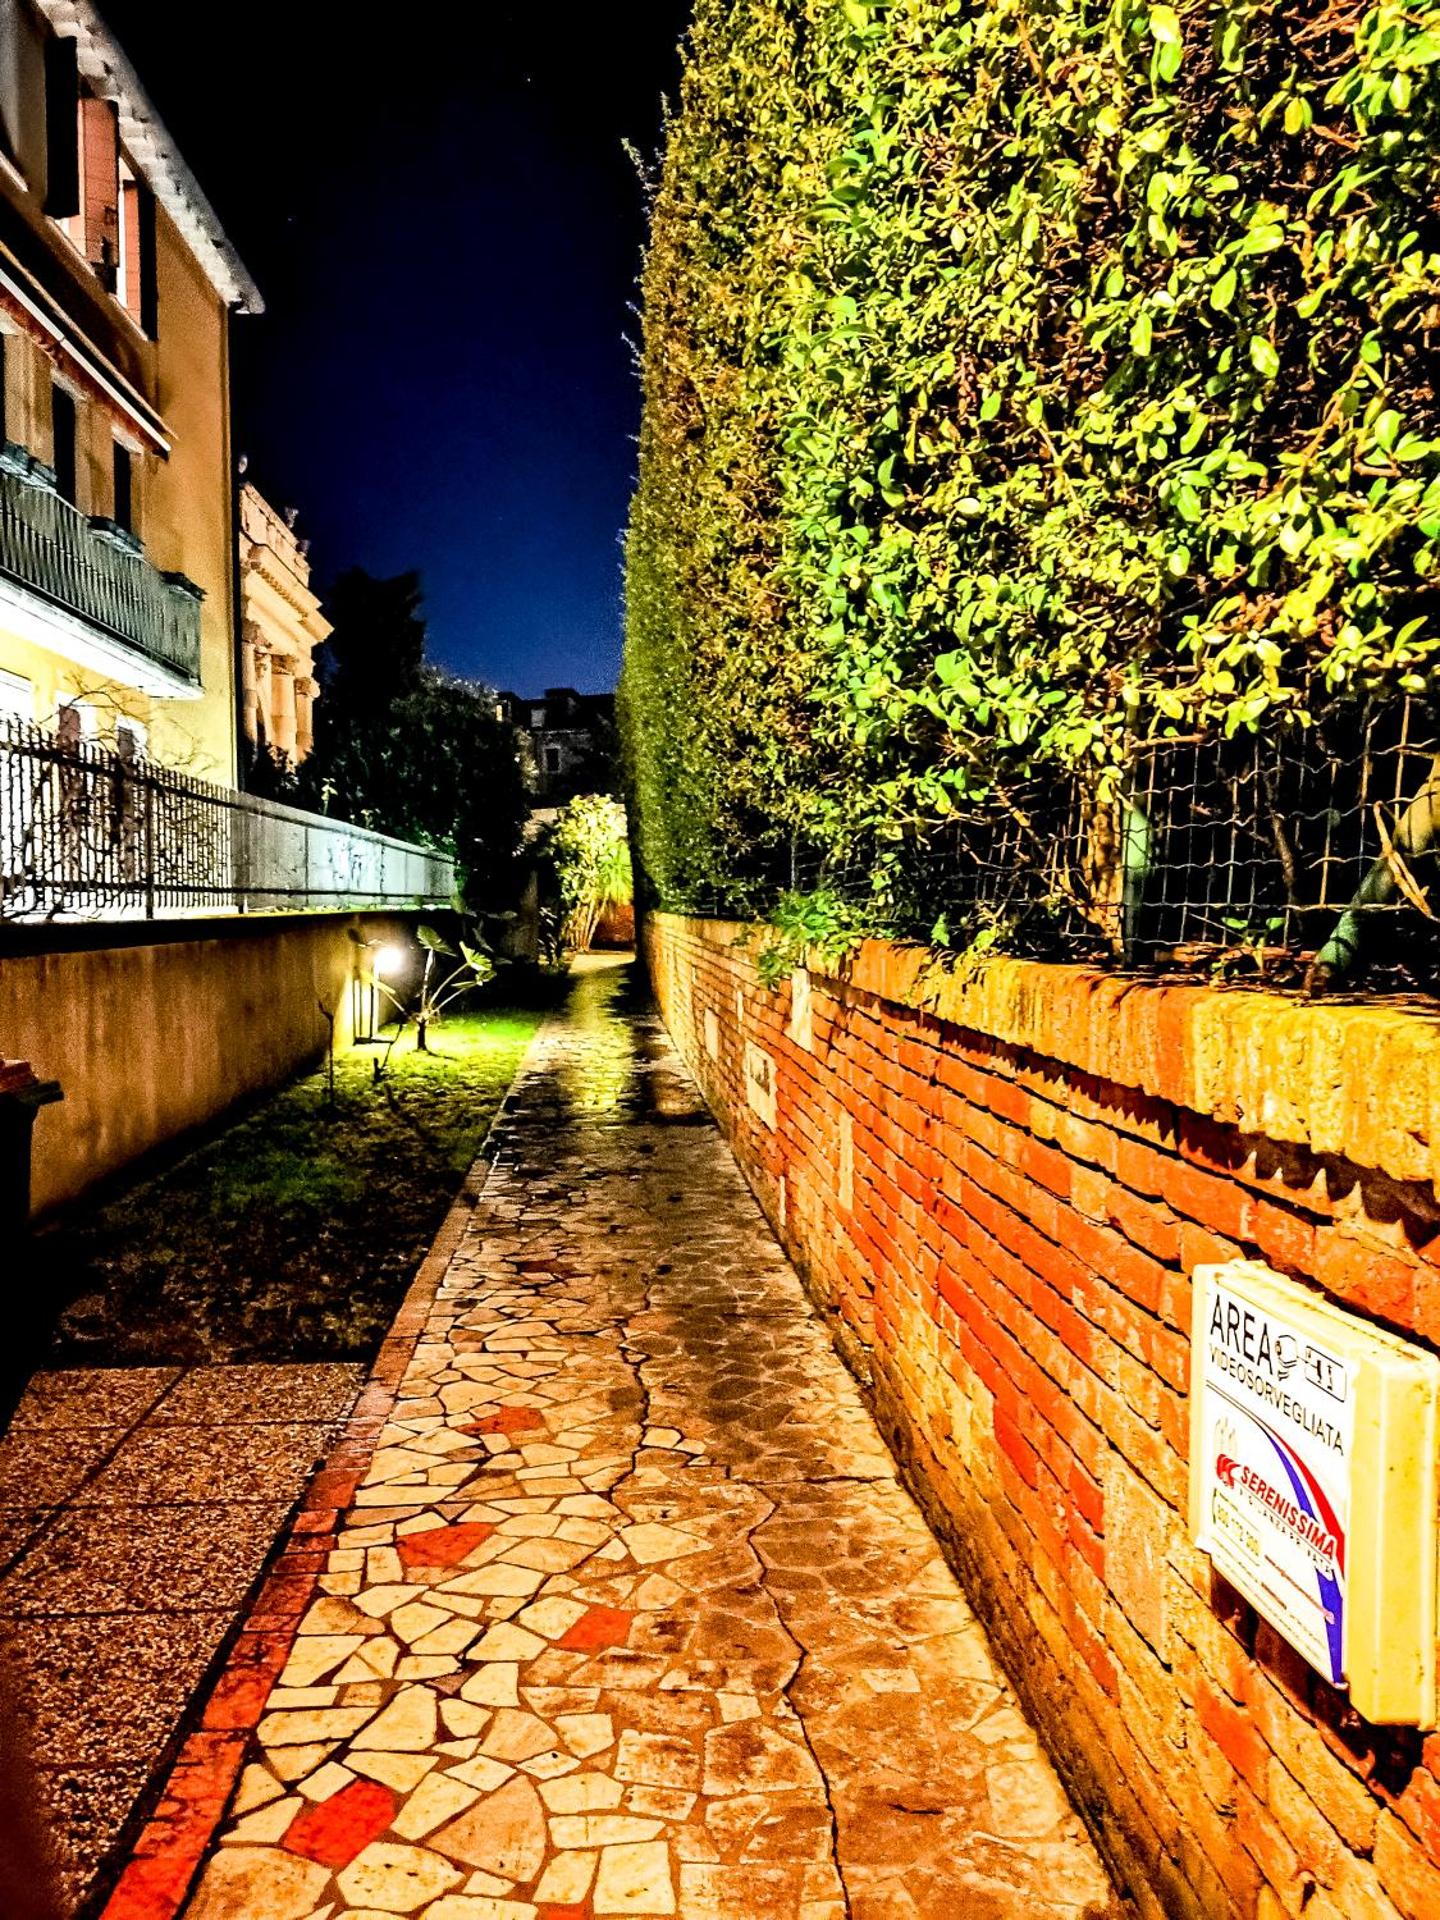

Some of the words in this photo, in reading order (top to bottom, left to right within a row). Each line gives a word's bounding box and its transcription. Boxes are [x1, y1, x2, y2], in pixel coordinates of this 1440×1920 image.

[1210, 1294, 1273, 1375] AREA
[1209, 1343, 1344, 1456] VIDEOSORVEGLIATA
[1240, 1466, 1335, 1561] SERENISSIMA
